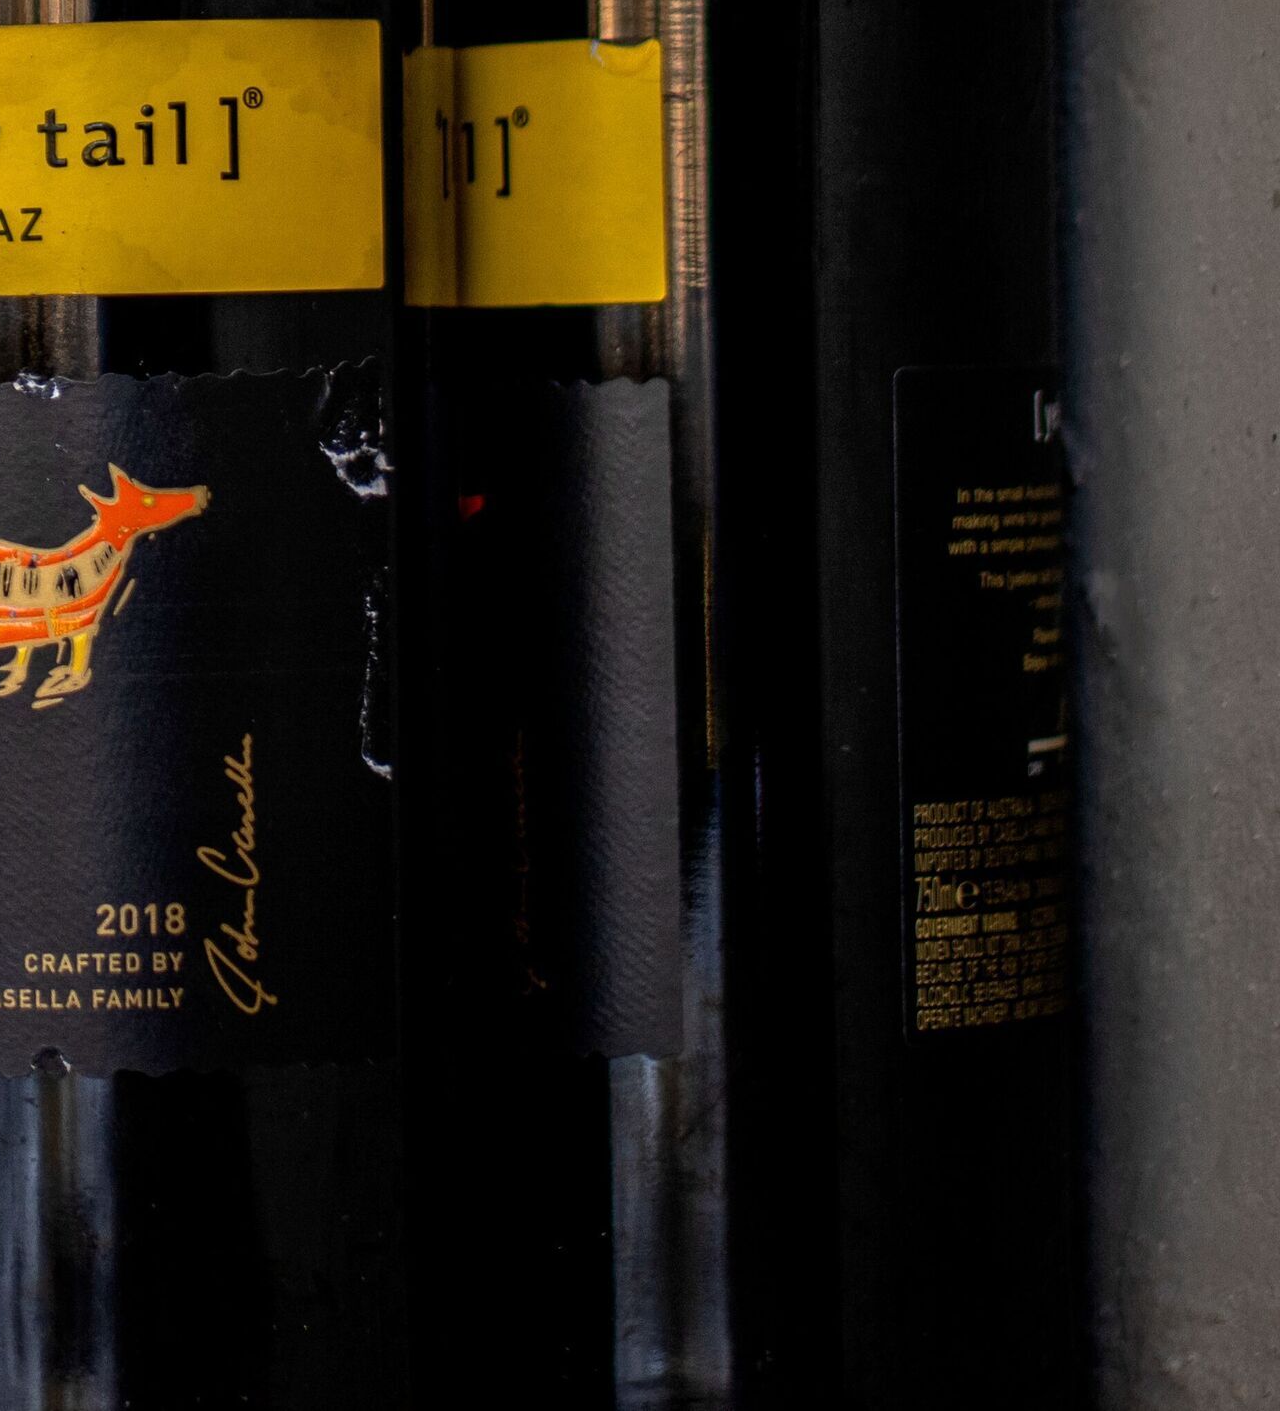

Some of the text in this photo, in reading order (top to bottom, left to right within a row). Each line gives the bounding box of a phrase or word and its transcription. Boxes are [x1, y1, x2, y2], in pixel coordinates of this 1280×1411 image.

[95, 901, 187, 937] 2018
[24, 951, 184, 974] CRAFTED BY
[91, 986, 184, 1010] FAMILY
